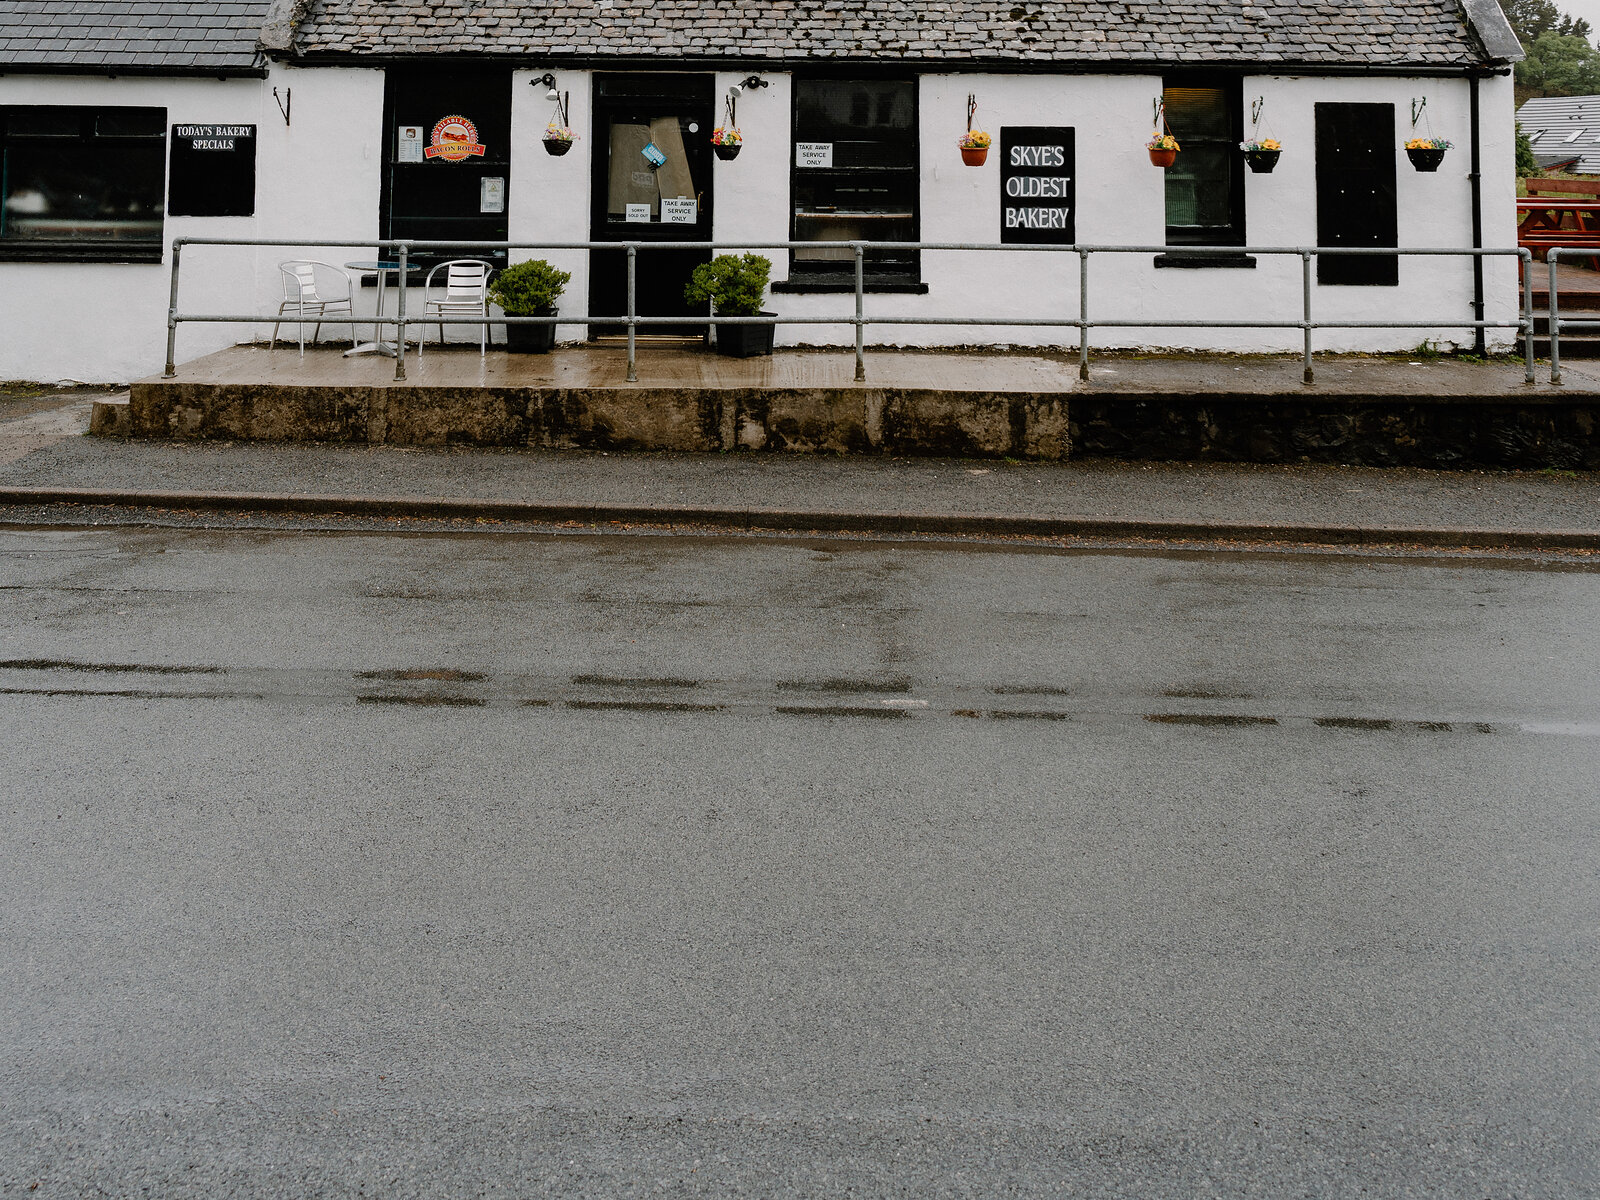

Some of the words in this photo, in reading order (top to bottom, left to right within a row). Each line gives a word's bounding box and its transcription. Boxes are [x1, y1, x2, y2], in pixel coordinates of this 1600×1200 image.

[177, 126, 212, 136] TODAY'S
[216, 126, 251, 136] BAKERY
[193, 140, 234, 150] SPECIALS
[430, 145, 456, 154] BACON
[457, 145, 480, 153] ROLLS
[1010, 145, 1064, 166] SKYE'S
[1006, 177, 1070, 197] OLDEST
[1005, 207, 1069, 228] BAKERY
